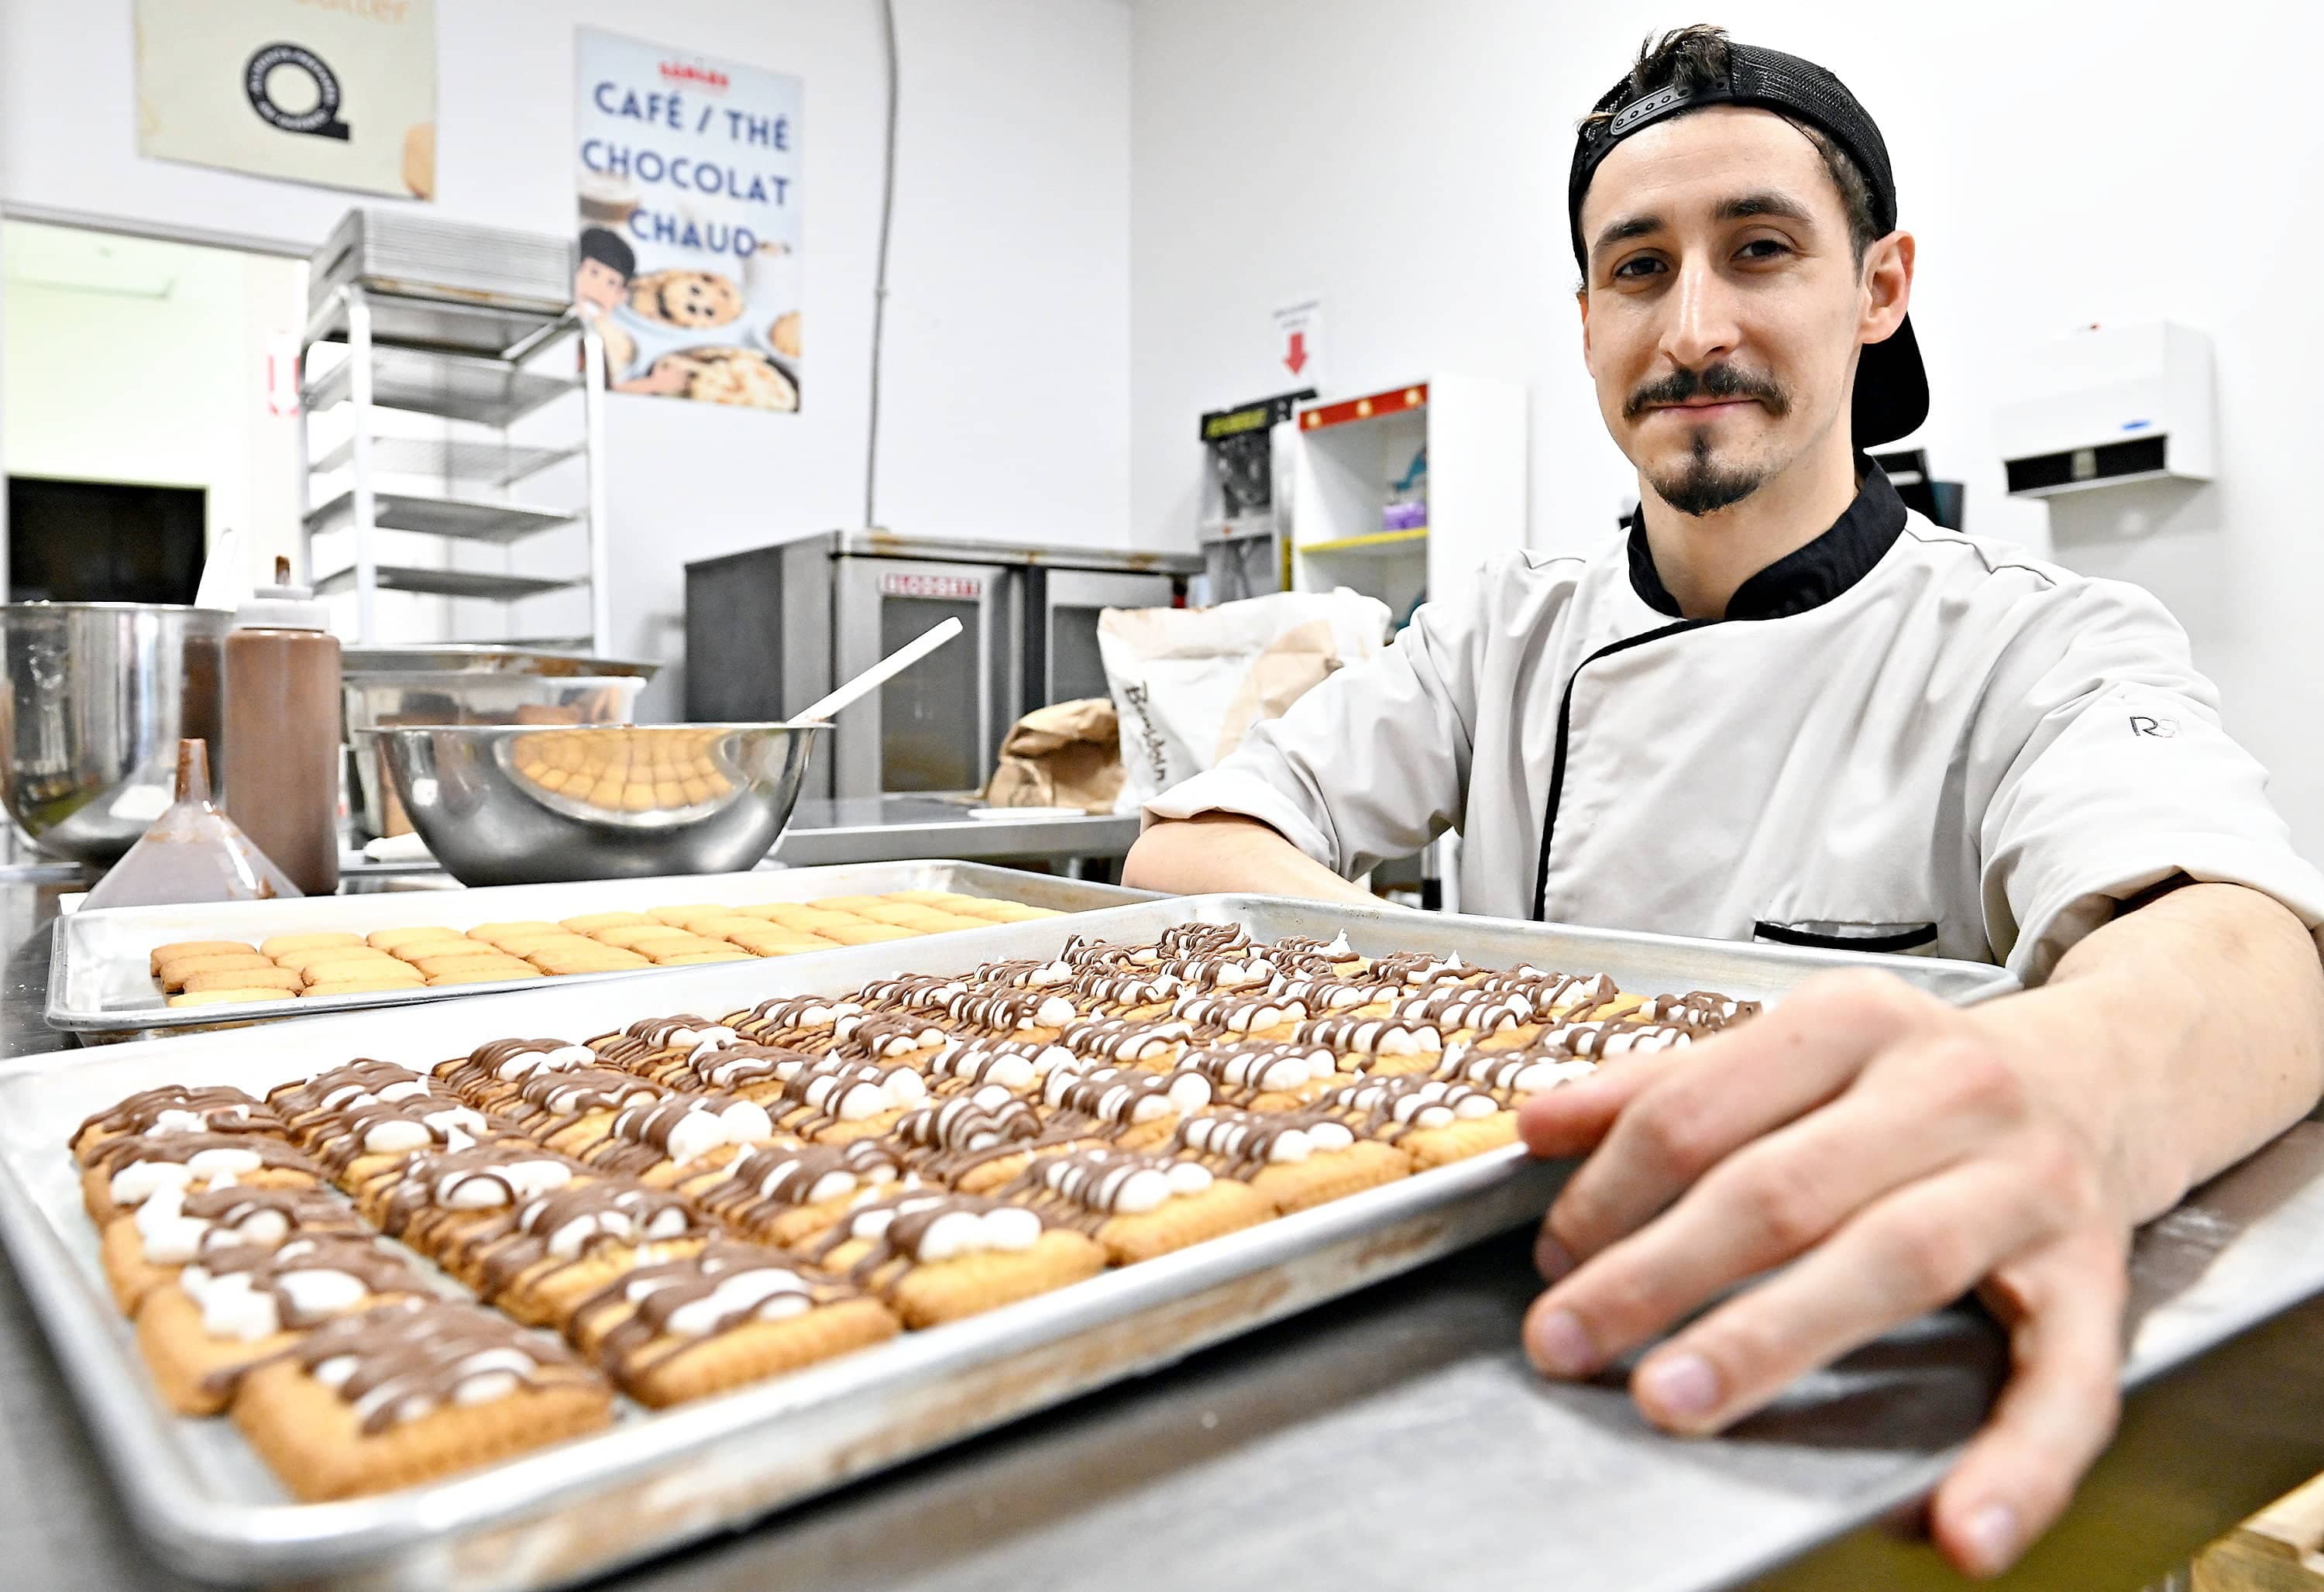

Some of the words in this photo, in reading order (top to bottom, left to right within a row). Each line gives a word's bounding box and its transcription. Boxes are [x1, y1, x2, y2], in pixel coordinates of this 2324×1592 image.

[594, 81, 682, 130] CAFÉ
[725, 108, 789, 151] THÉ
[582, 139, 789, 206] CHOCOLAT
[629, 208, 757, 258] CHAUD
